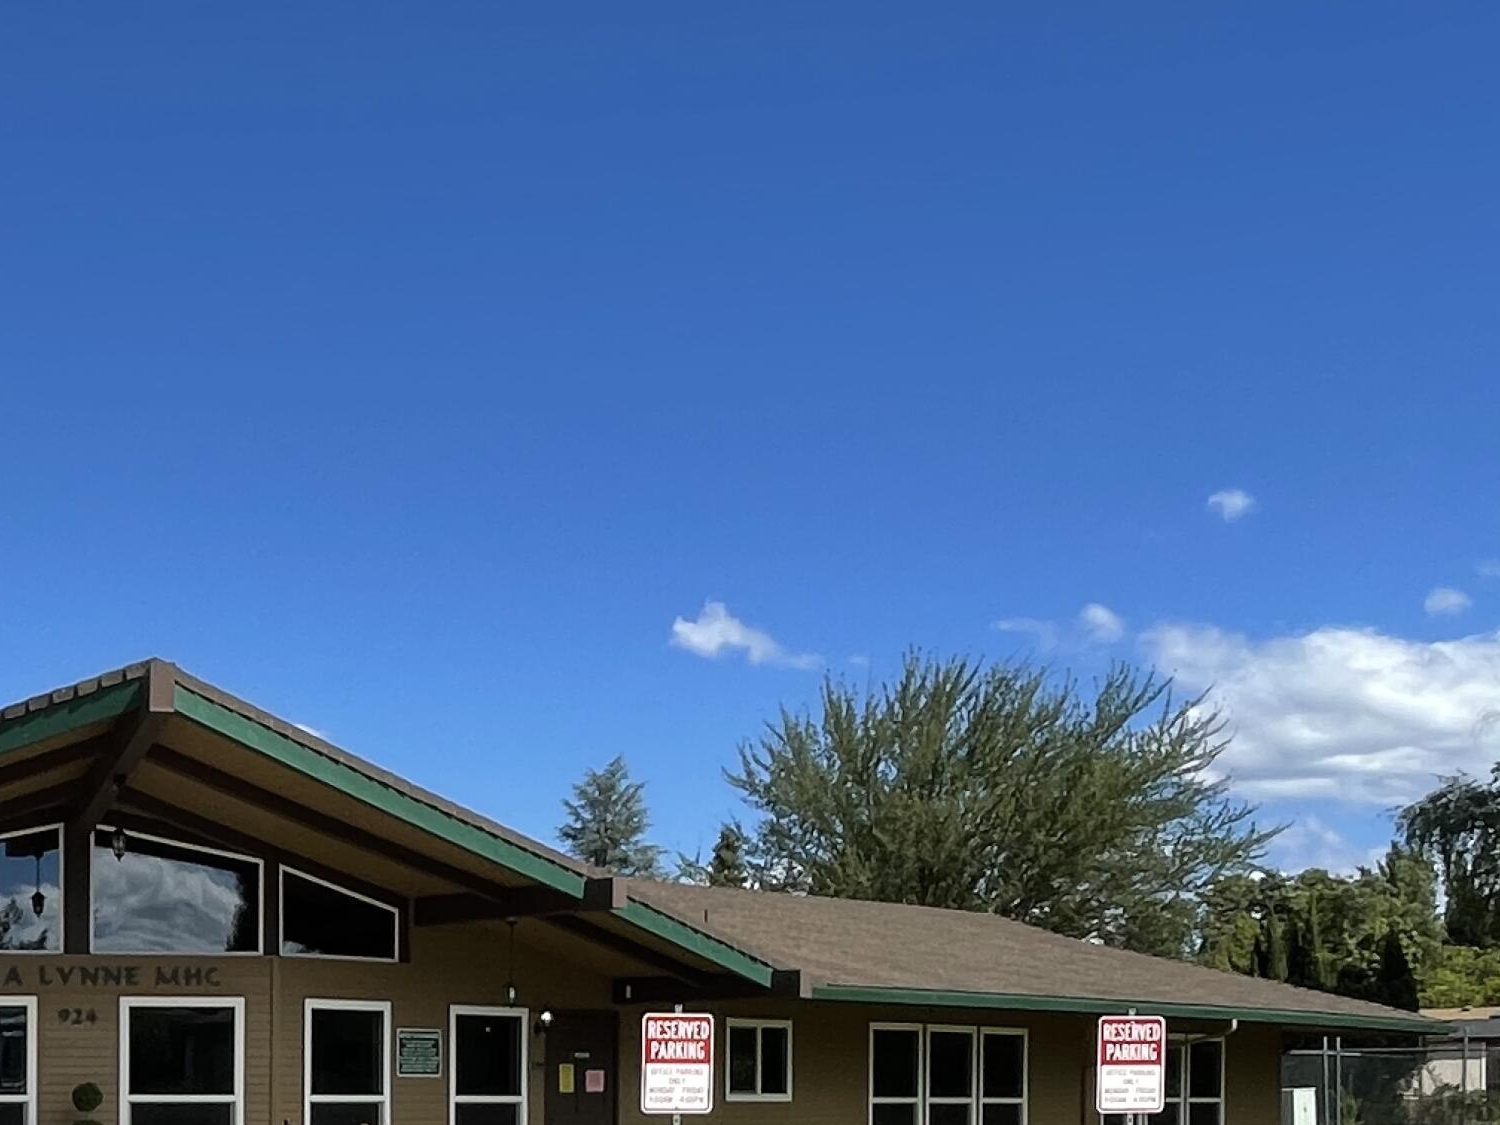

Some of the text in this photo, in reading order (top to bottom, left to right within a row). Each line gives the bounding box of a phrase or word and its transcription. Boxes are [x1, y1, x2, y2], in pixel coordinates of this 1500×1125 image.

[40, 964, 141, 987] LYNNE
[154, 964, 221, 988] MHC
[57, 1007, 98, 1026] 924
[648, 1020, 709, 1040] RESERVED
[1103, 1023, 1160, 1042] RESERVED
[650, 1040, 705, 1060] PARKING
[1105, 1043, 1158, 1061] PARKING
